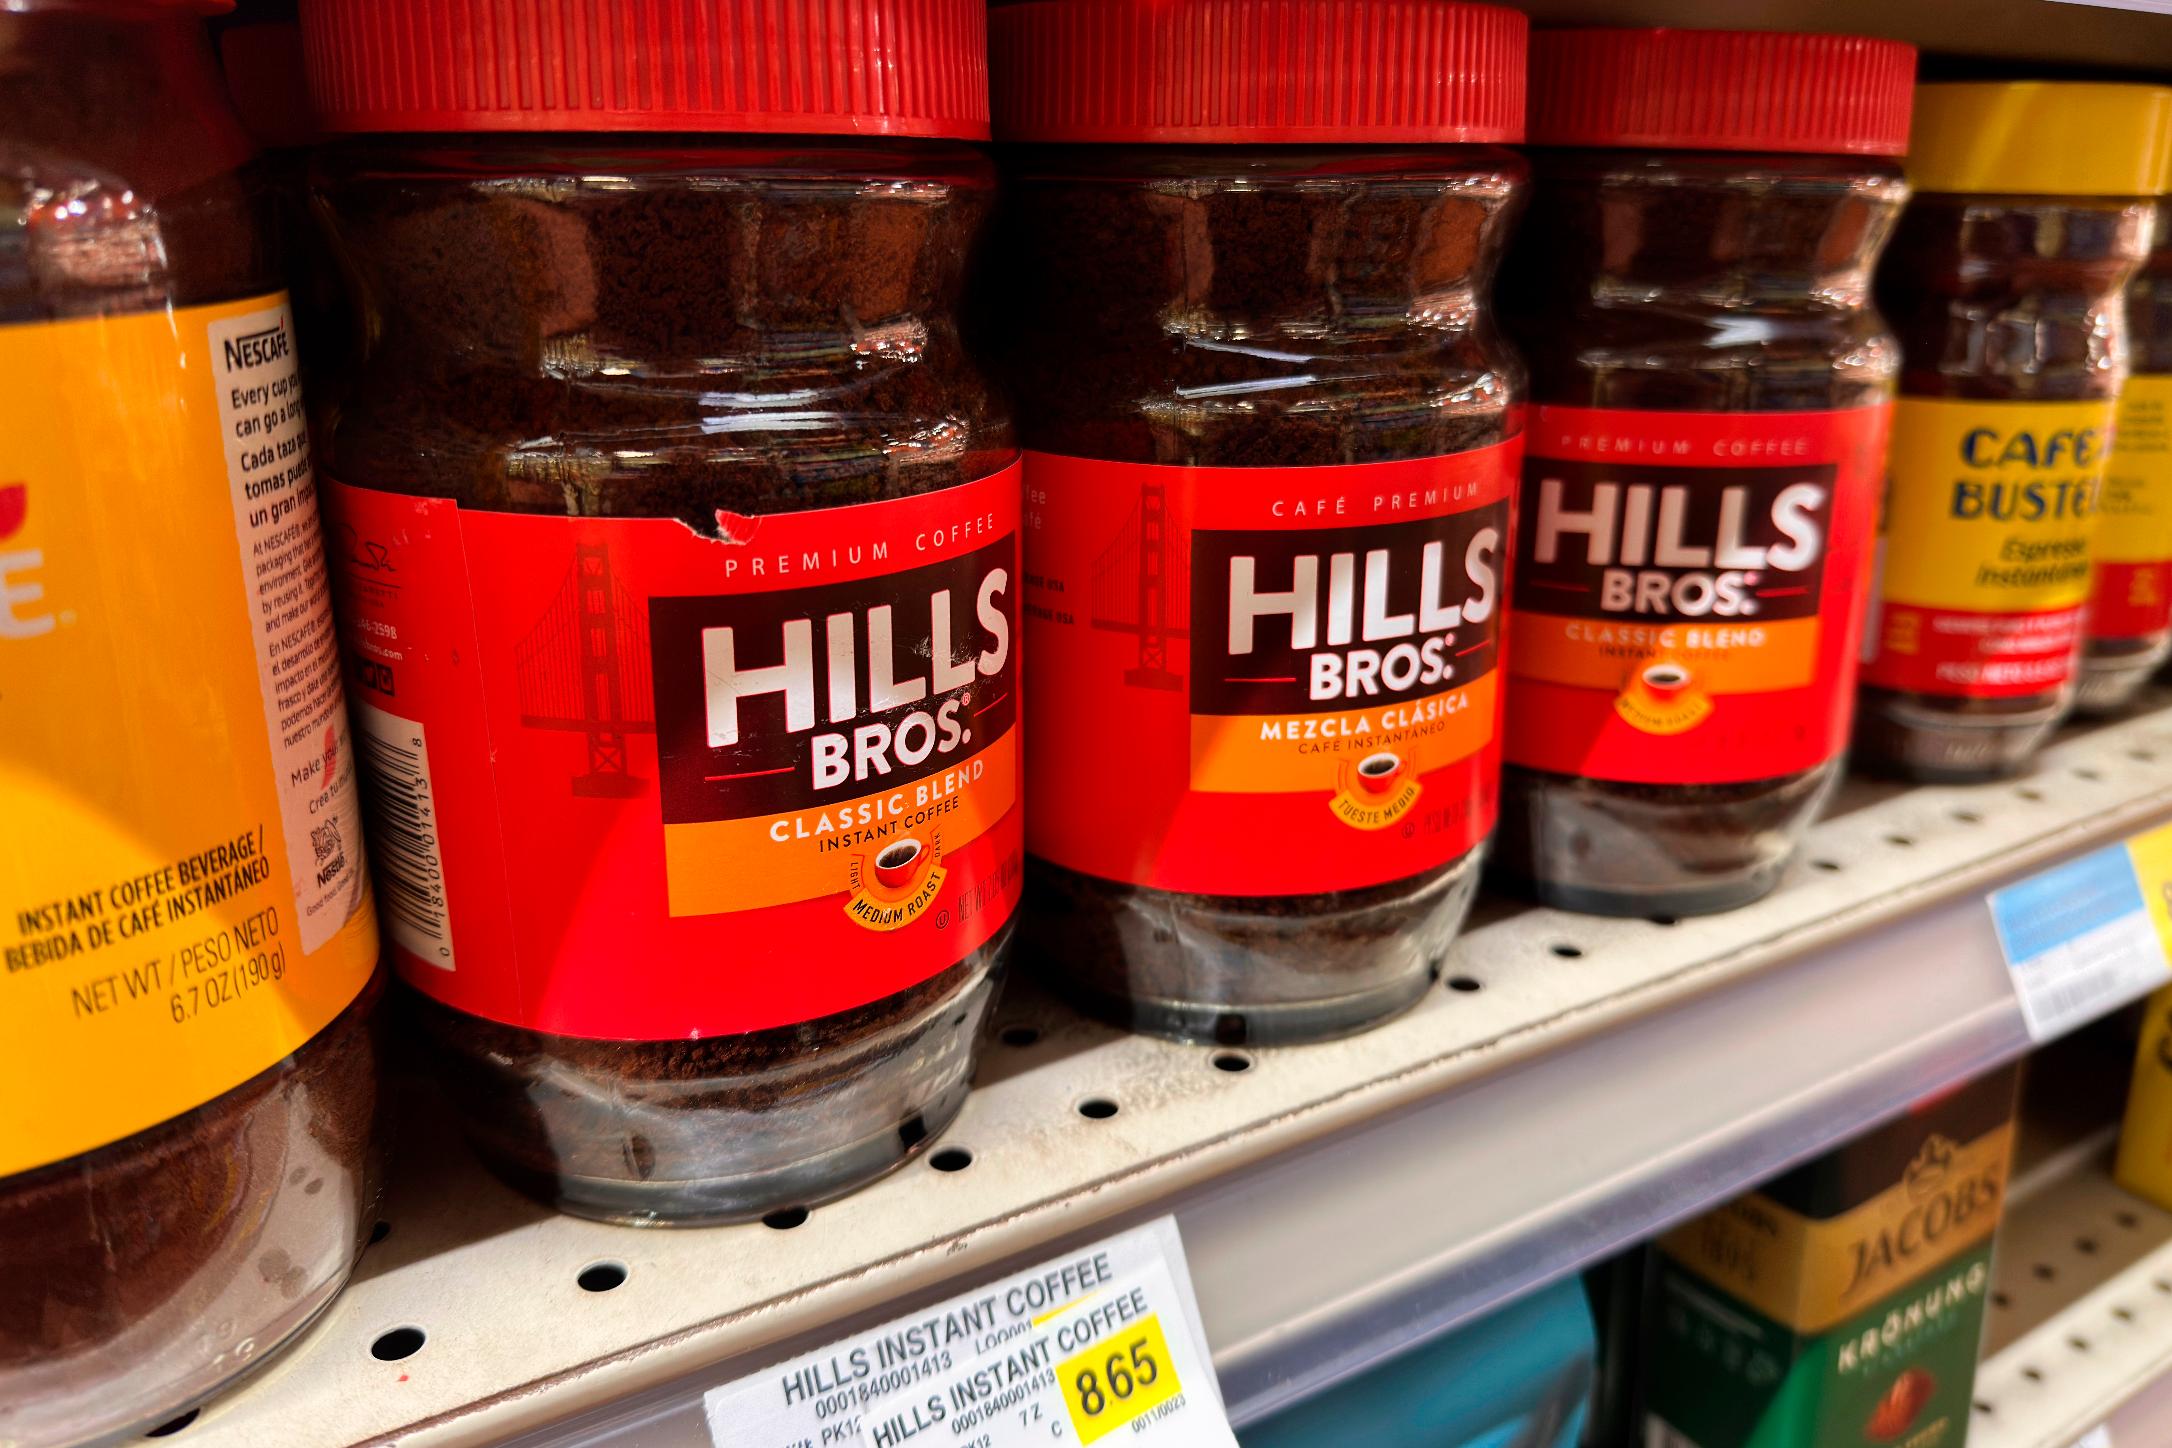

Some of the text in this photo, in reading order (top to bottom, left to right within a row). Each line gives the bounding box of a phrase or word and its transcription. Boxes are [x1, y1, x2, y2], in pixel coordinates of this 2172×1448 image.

[231, 382, 270, 410] Every
[271, 378, 288, 398] cup
[235, 414, 261, 438] can
[263, 409, 279, 434] go
[280, 407, 287, 423] a
[1561, 433, 1809, 457] PREMIUM COFFEE
[241, 445, 275, 472] Cada
[277, 437, 297, 460] taza
[245, 471, 286, 501] tomas
[249, 508, 269, 529] un
[271, 494, 297, 525] gran
[1271, 481, 1478, 517] CAFÉ PREMIUM
[1951, 479, 2098, 522] BUSTE
[725, 512, 994, 578] PREMIUM COFFEE
[1534, 478, 1826, 573] HILLS
[1228, 527, 1499, 655] HILLS
[701, 567, 1009, 749] HILLS
[1564, 623, 1767, 650] CLASSIC BLEND
[1260, 692, 1469, 741] MEZCLA CLÁSICA
[291, 757, 321, 789] Make
[309, 790, 331, 815] Crea
[769, 759, 985, 842] CLASSIC BLEND
[819, 795, 960, 853] INSTANT COFFEE
[1338, 799, 1380, 824] TUESTE
[18, 890, 105, 937] INSTANT
[110, 865, 175, 909] COFFEE
[177, 831, 256, 886] BEVERAGE
[425, 855, 446, 919] 18400
[850, 861, 861, 890] LIGHT
[852, 872, 942, 924] MEDIUM ROAST
[4, 855, 270, 974] BEBIDA DE CAFÉ INSTANTÁNEO
[70, 976, 119, 1019] NET
[122, 958, 163, 1001] WT
[181, 931, 232, 979] PESO
[233, 906, 280, 953] NETO
[169, 986, 200, 1024] 6.7
[204, 971, 233, 1008] OZ
[1839, 1162, 1999, 1302] JACOBS
[782, 1251, 1113, 1406] HILLS INSTANT COFFEE
[814, 1350, 954, 1420] 0001840001413
[872, 1286, 1148, 1448] HILLS INSTANT COFFEE
[951, 1366, 1056, 1435] 0001840001413
